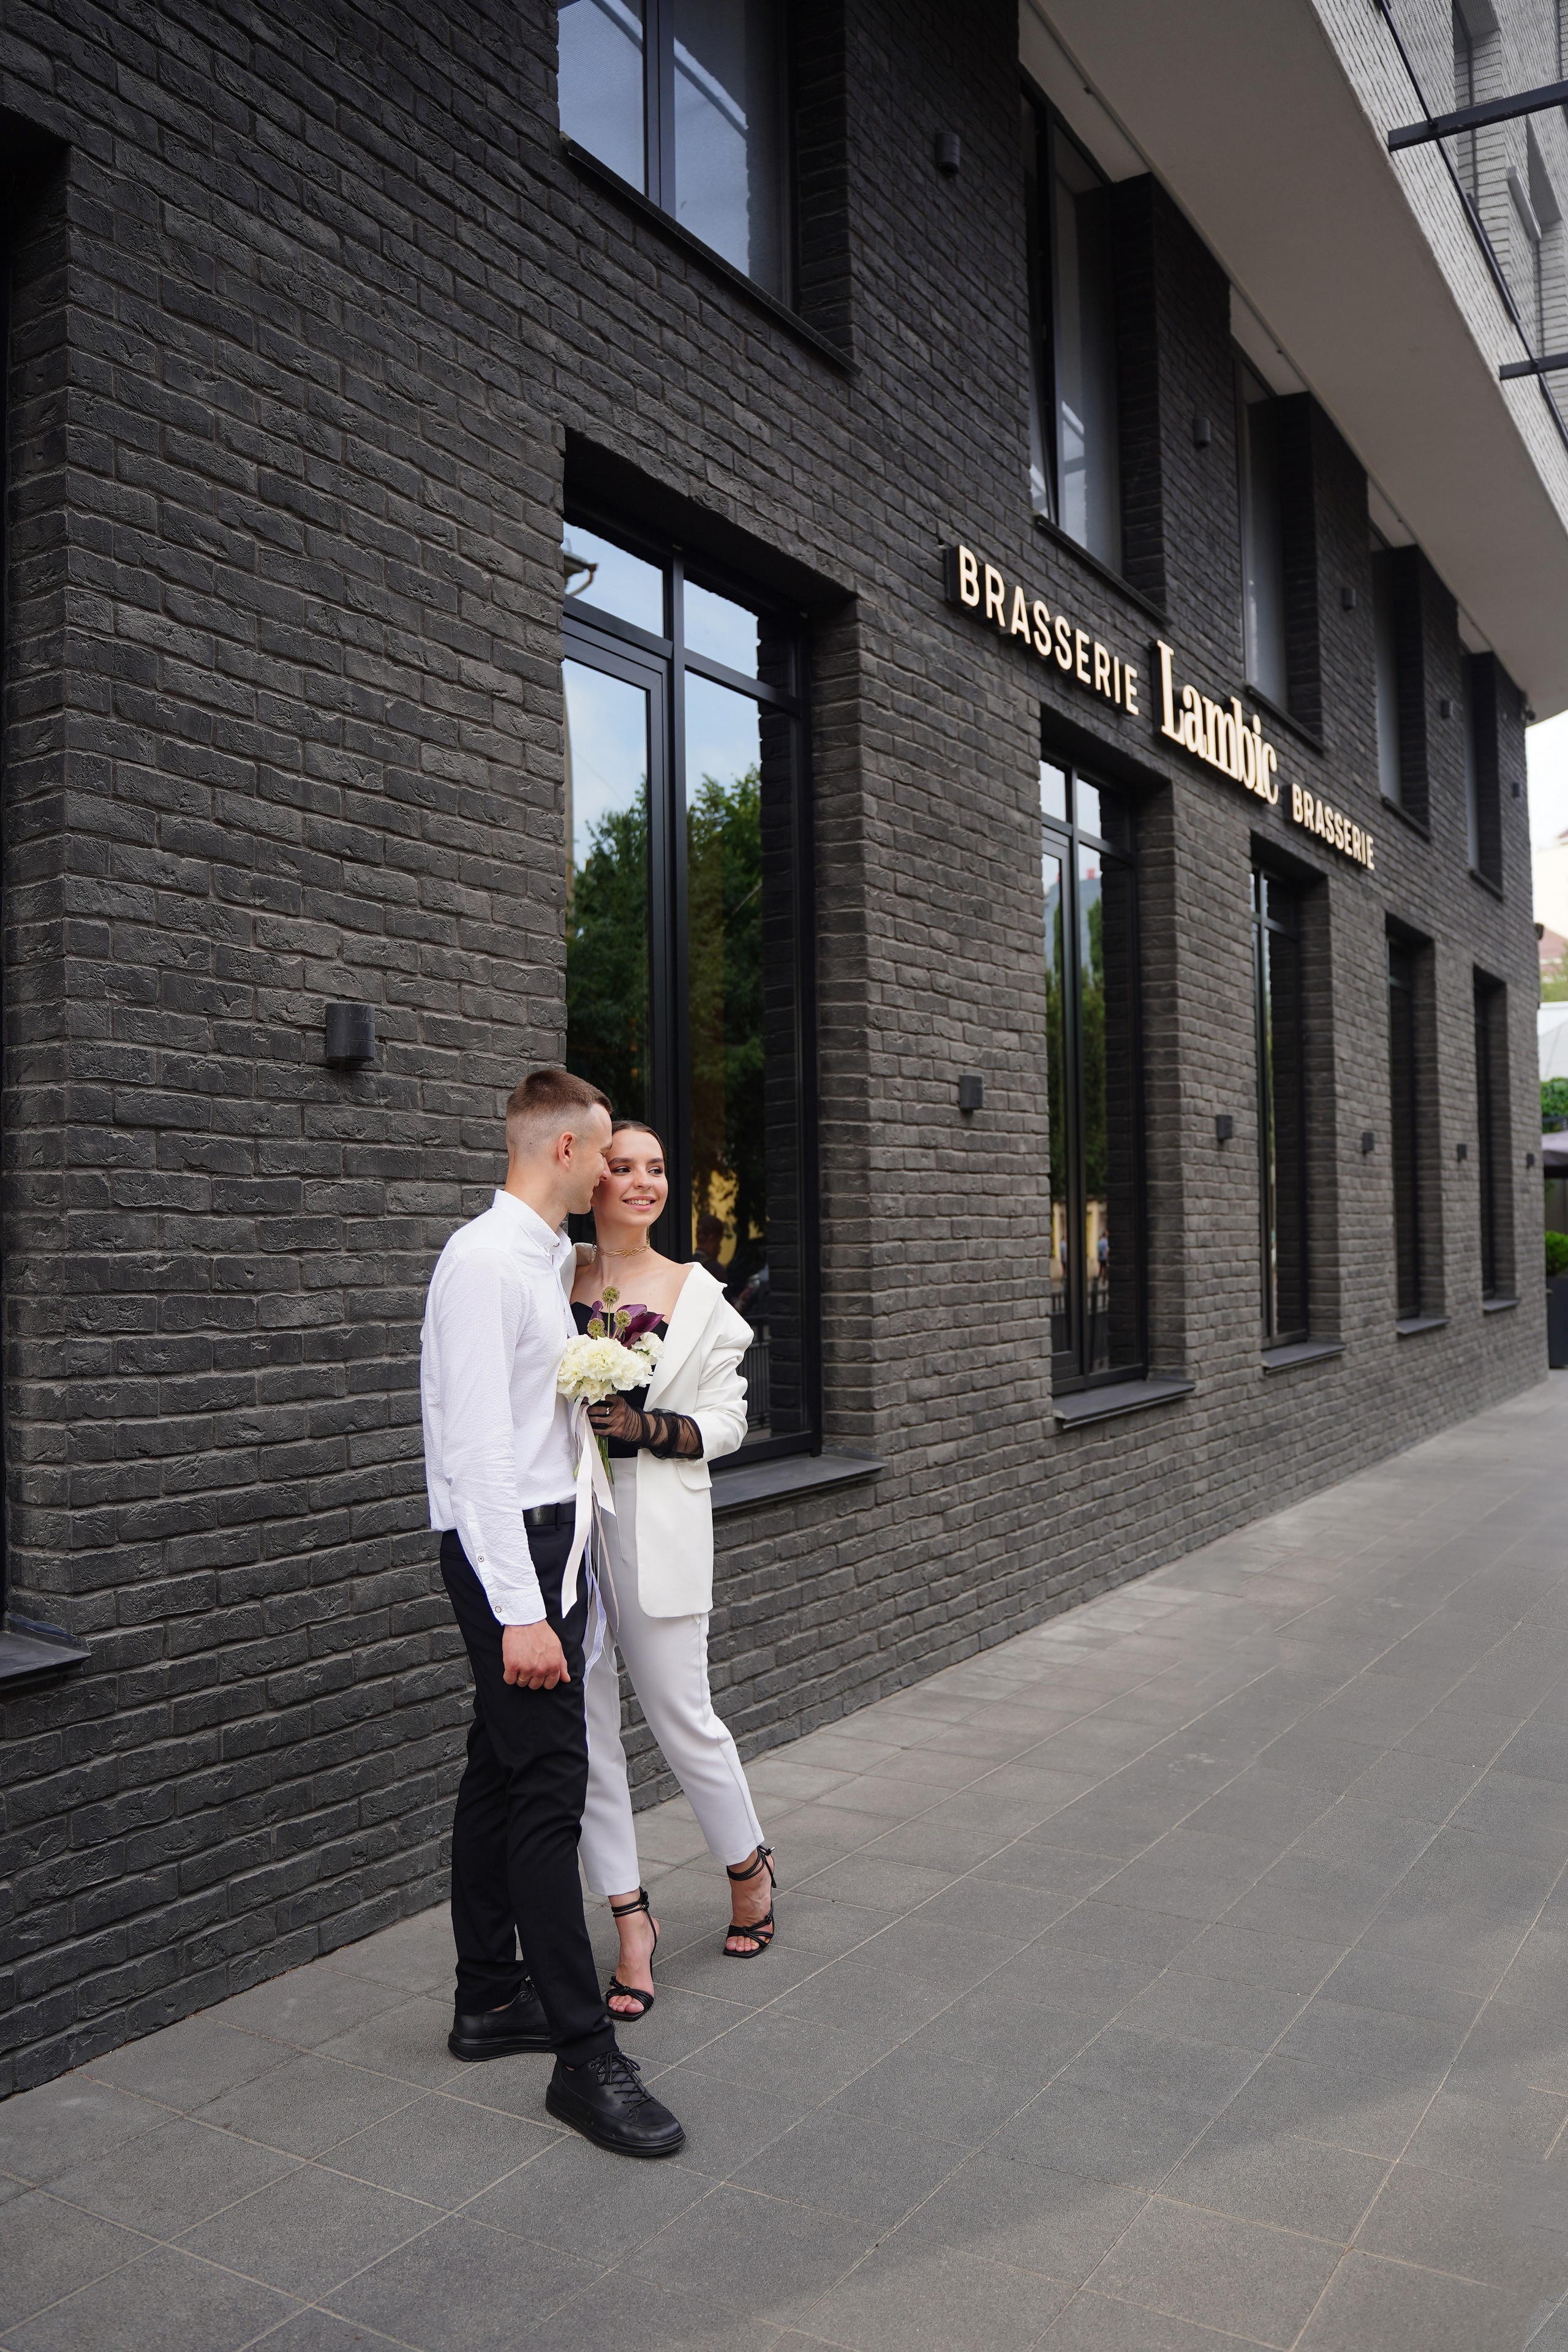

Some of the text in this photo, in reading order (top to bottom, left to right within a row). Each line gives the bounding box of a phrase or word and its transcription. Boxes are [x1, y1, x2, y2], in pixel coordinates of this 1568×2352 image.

[958, 545, 1376, 870] BRASSERIE Lambic BRASSERIE
